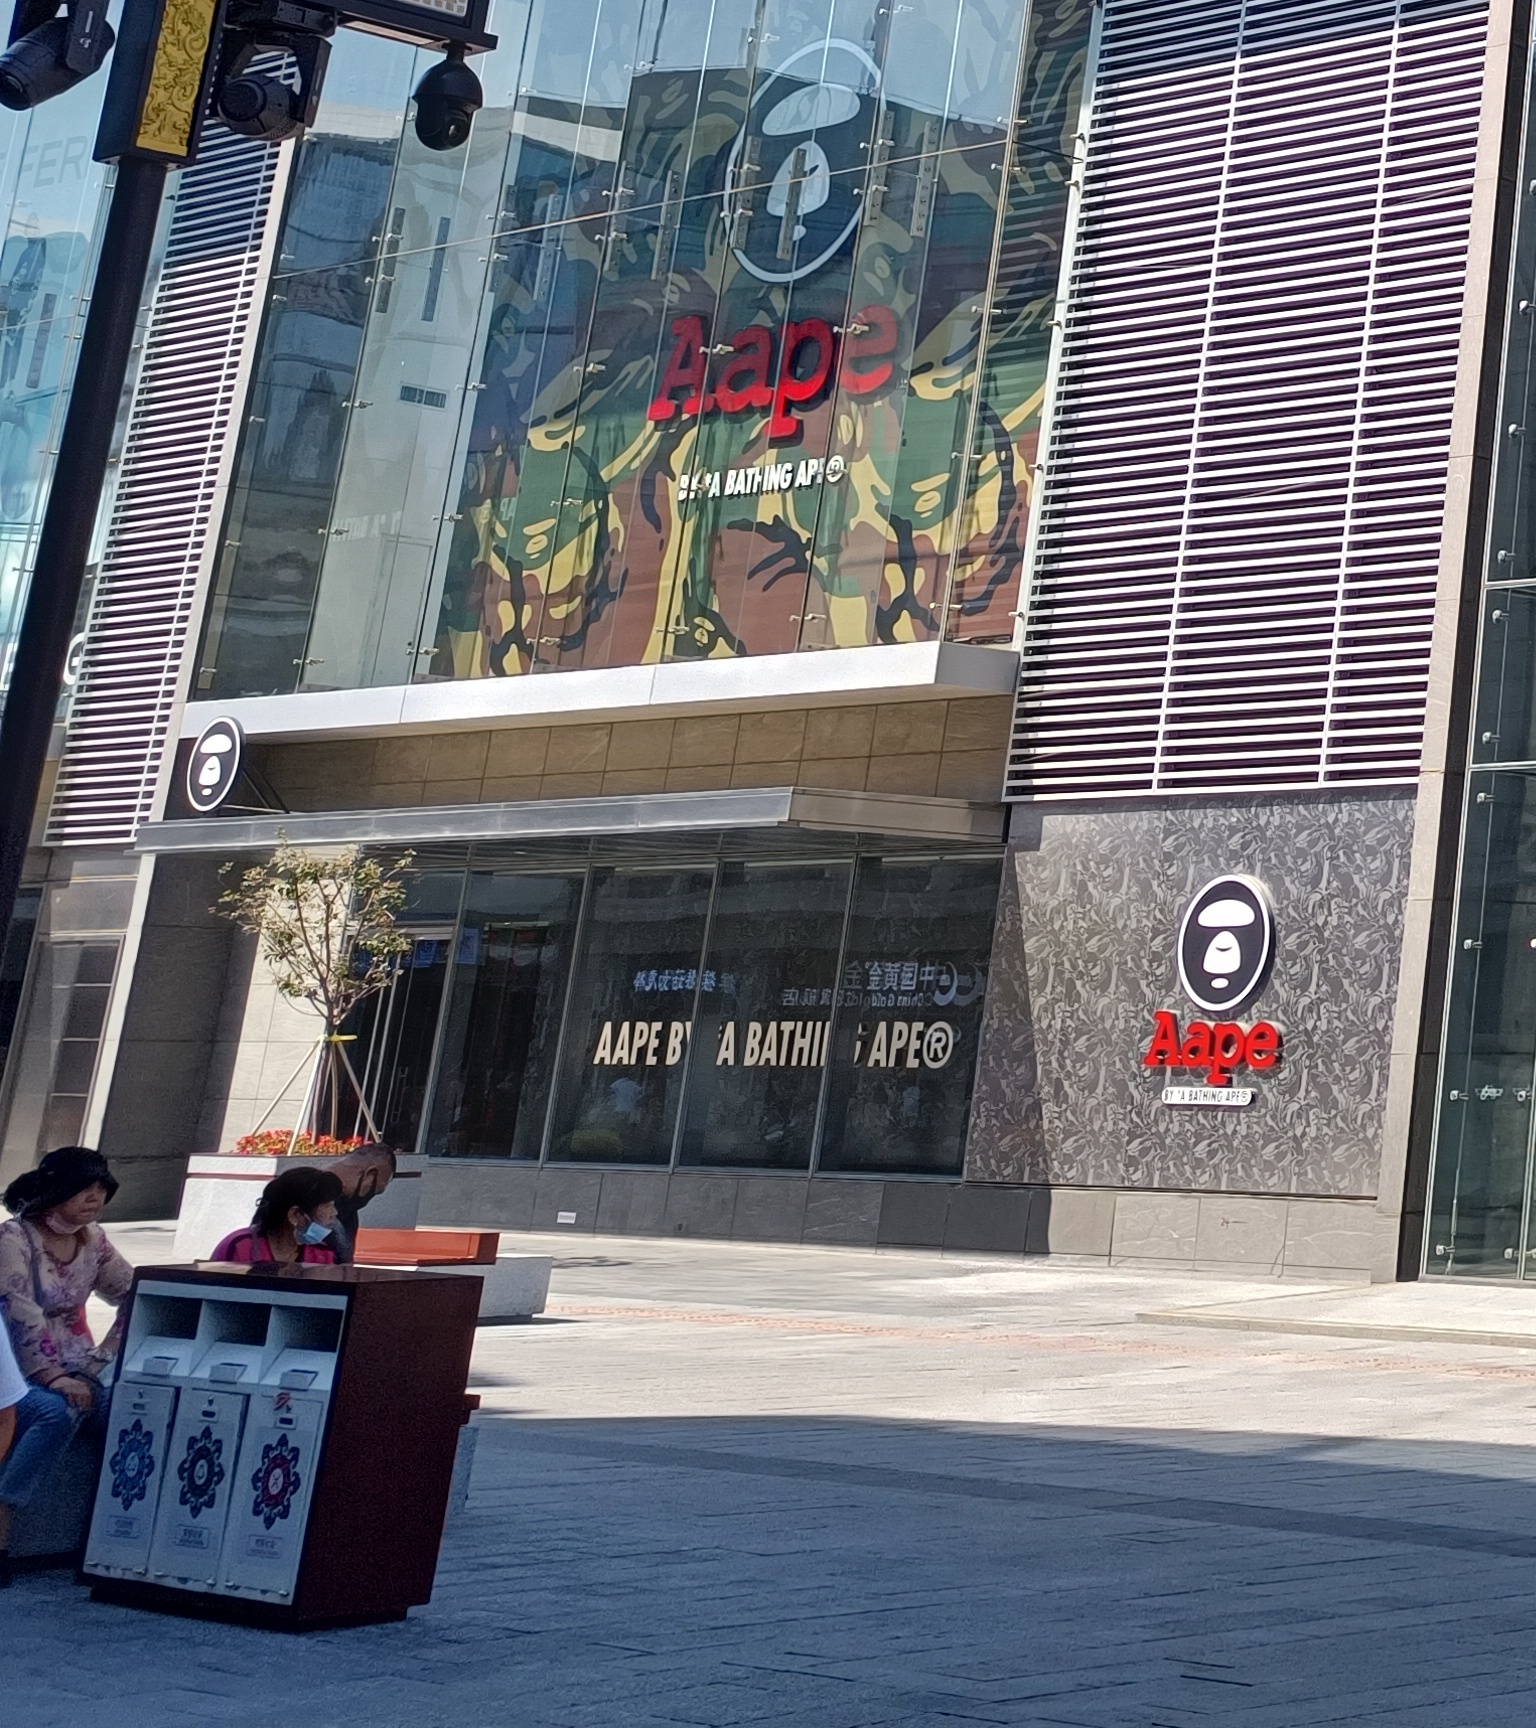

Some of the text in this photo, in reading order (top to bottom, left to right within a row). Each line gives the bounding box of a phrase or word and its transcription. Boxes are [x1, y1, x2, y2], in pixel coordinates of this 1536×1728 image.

[647, 304, 898, 438] Aape
[724, 462, 793, 496] BATHING
[593, 1021, 662, 1066] AAPE
[1143, 1011, 1279, 1086] Aape
[1188, 1089, 1223, 1103] BATHING
